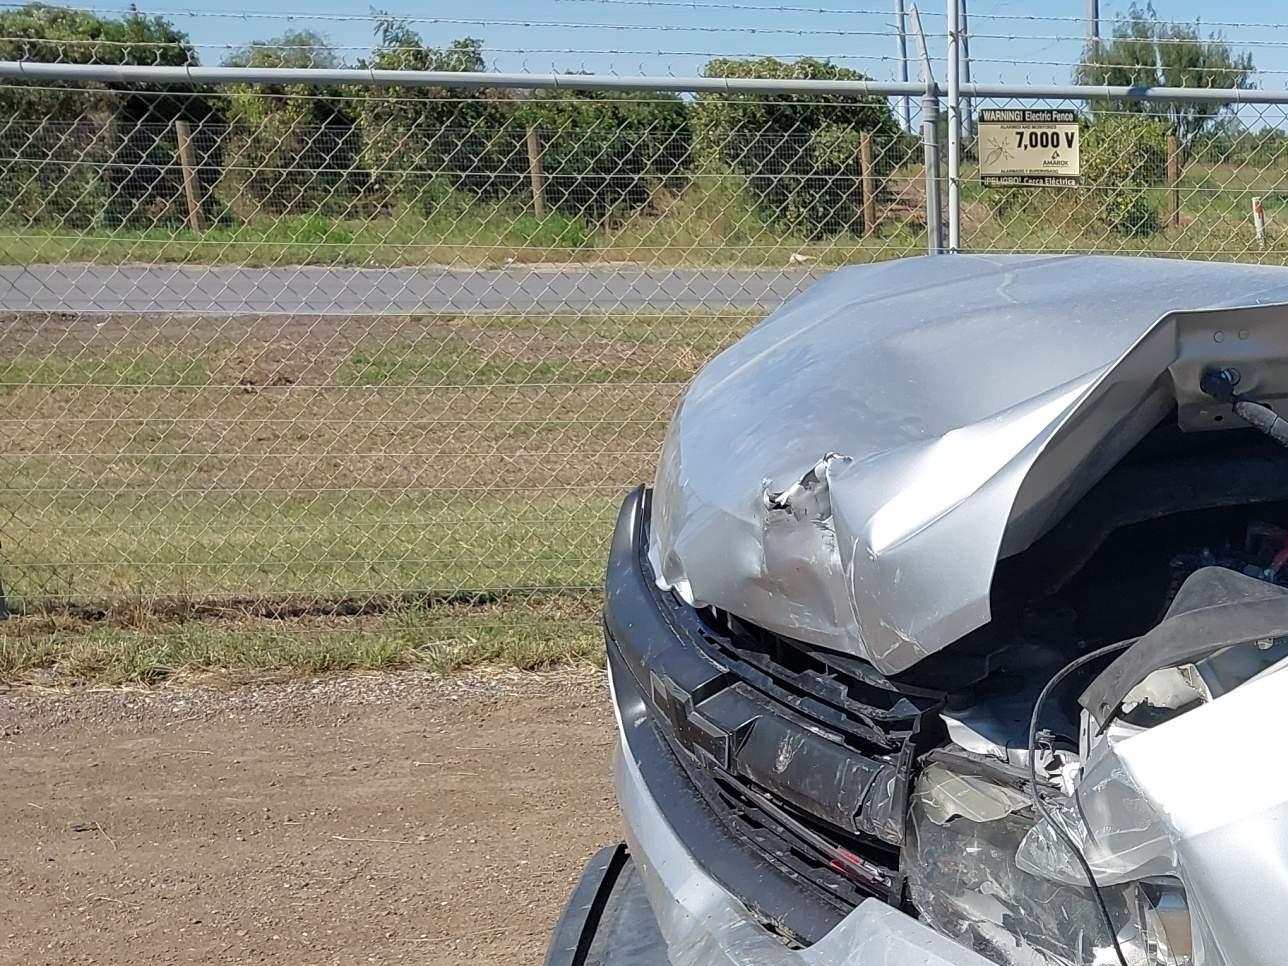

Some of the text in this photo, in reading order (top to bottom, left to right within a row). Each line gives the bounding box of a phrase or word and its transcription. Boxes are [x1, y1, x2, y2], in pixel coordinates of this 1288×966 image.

[983, 110, 1074, 121] WARNING! Electric Fence
[1015, 131, 1075, 151] 7,000 V
[1023, 177, 1044, 185] Cerca
[1044, 177, 1076, 186] Eléctrica
